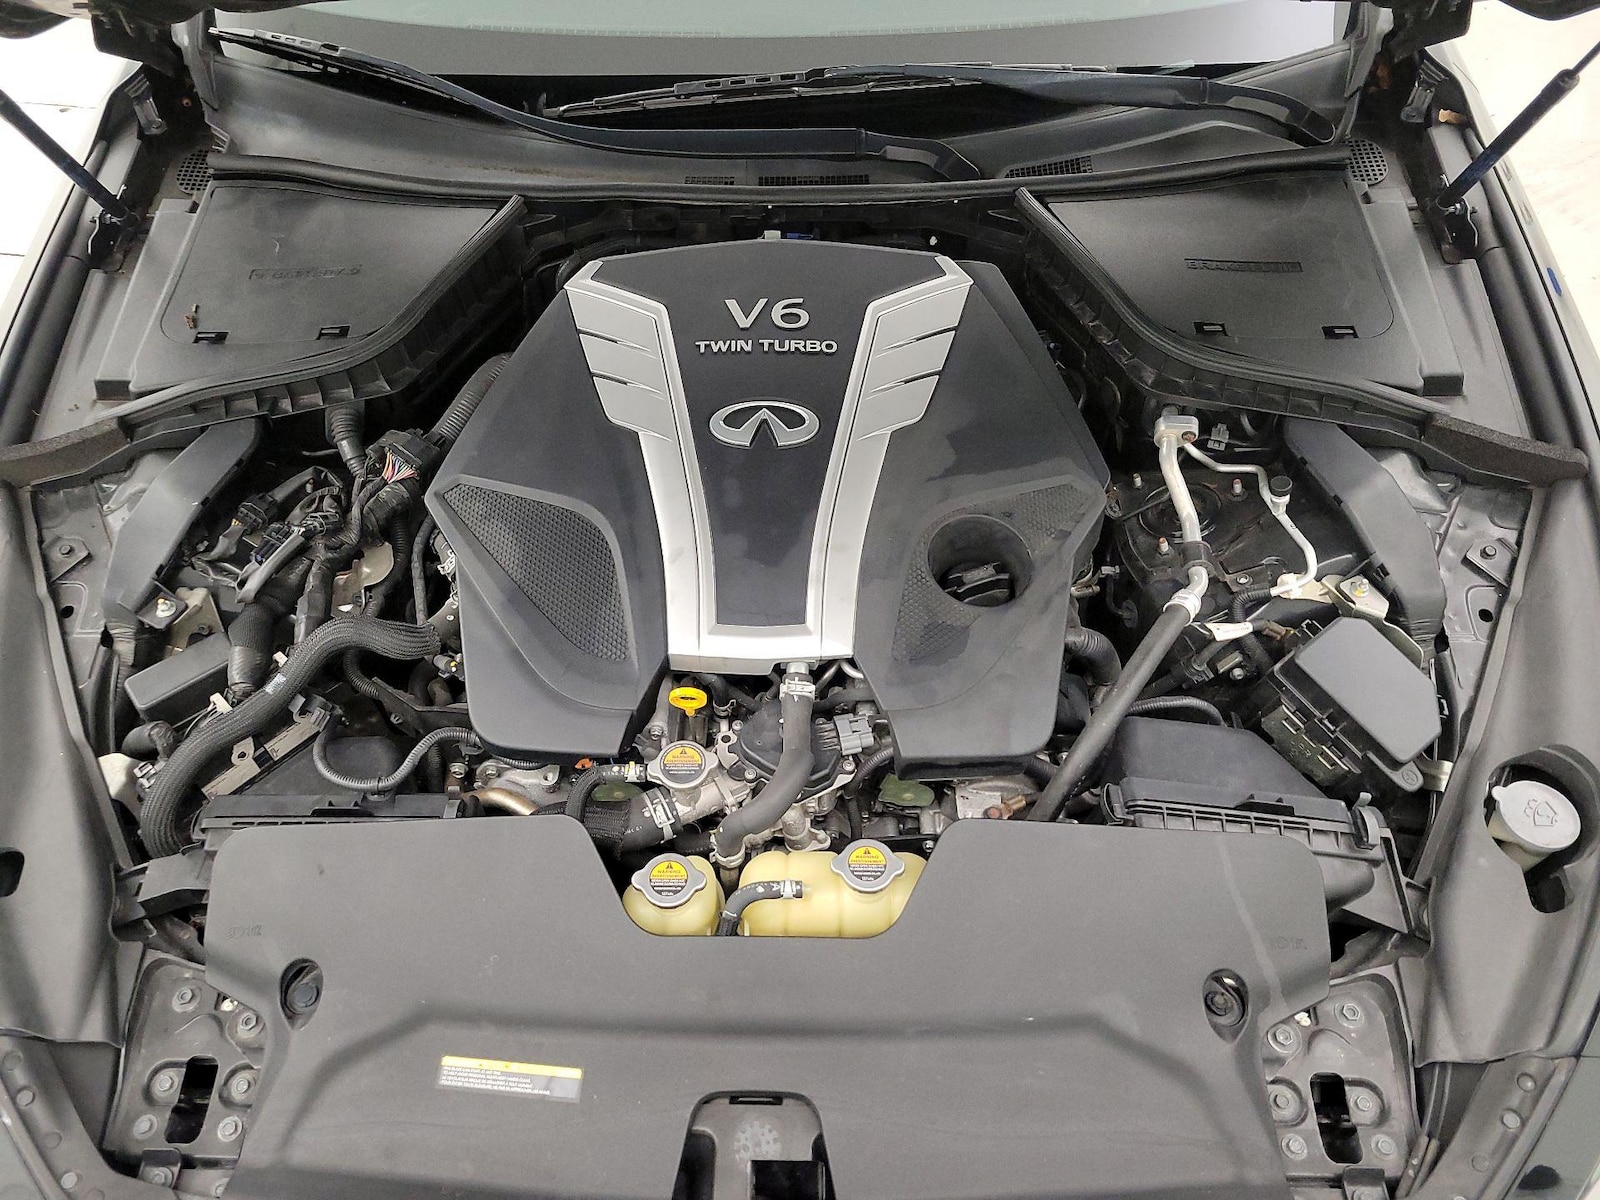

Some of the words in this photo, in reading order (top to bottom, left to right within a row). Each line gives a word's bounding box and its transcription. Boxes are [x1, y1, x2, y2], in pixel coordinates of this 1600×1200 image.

[724, 298, 810, 330] V6
[695, 340, 753, 354] TWIN
[758, 340, 838, 354] TURBO
